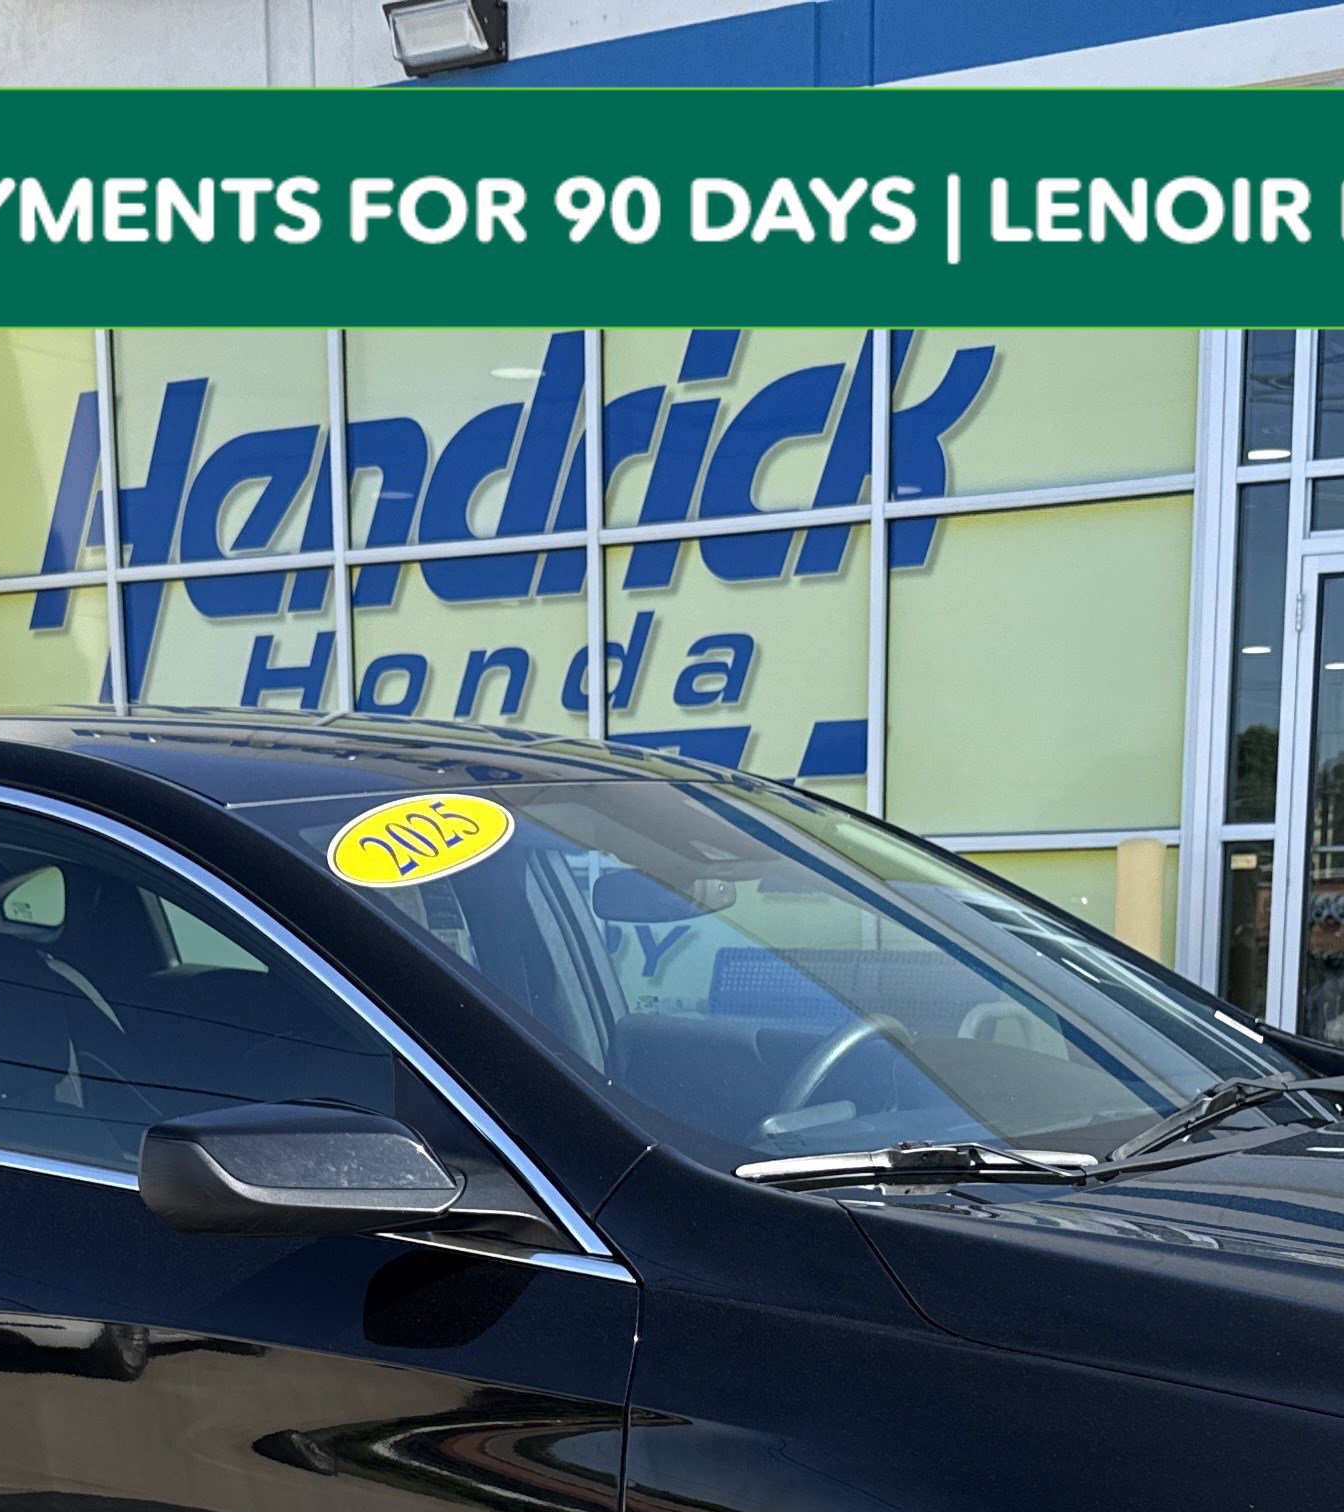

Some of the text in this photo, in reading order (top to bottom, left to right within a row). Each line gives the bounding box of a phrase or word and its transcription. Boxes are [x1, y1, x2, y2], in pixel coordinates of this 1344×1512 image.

[30, 326, 994, 704] Hendrick
[241, 610, 756, 717] Honda
[359, 801, 480, 876] 2025
